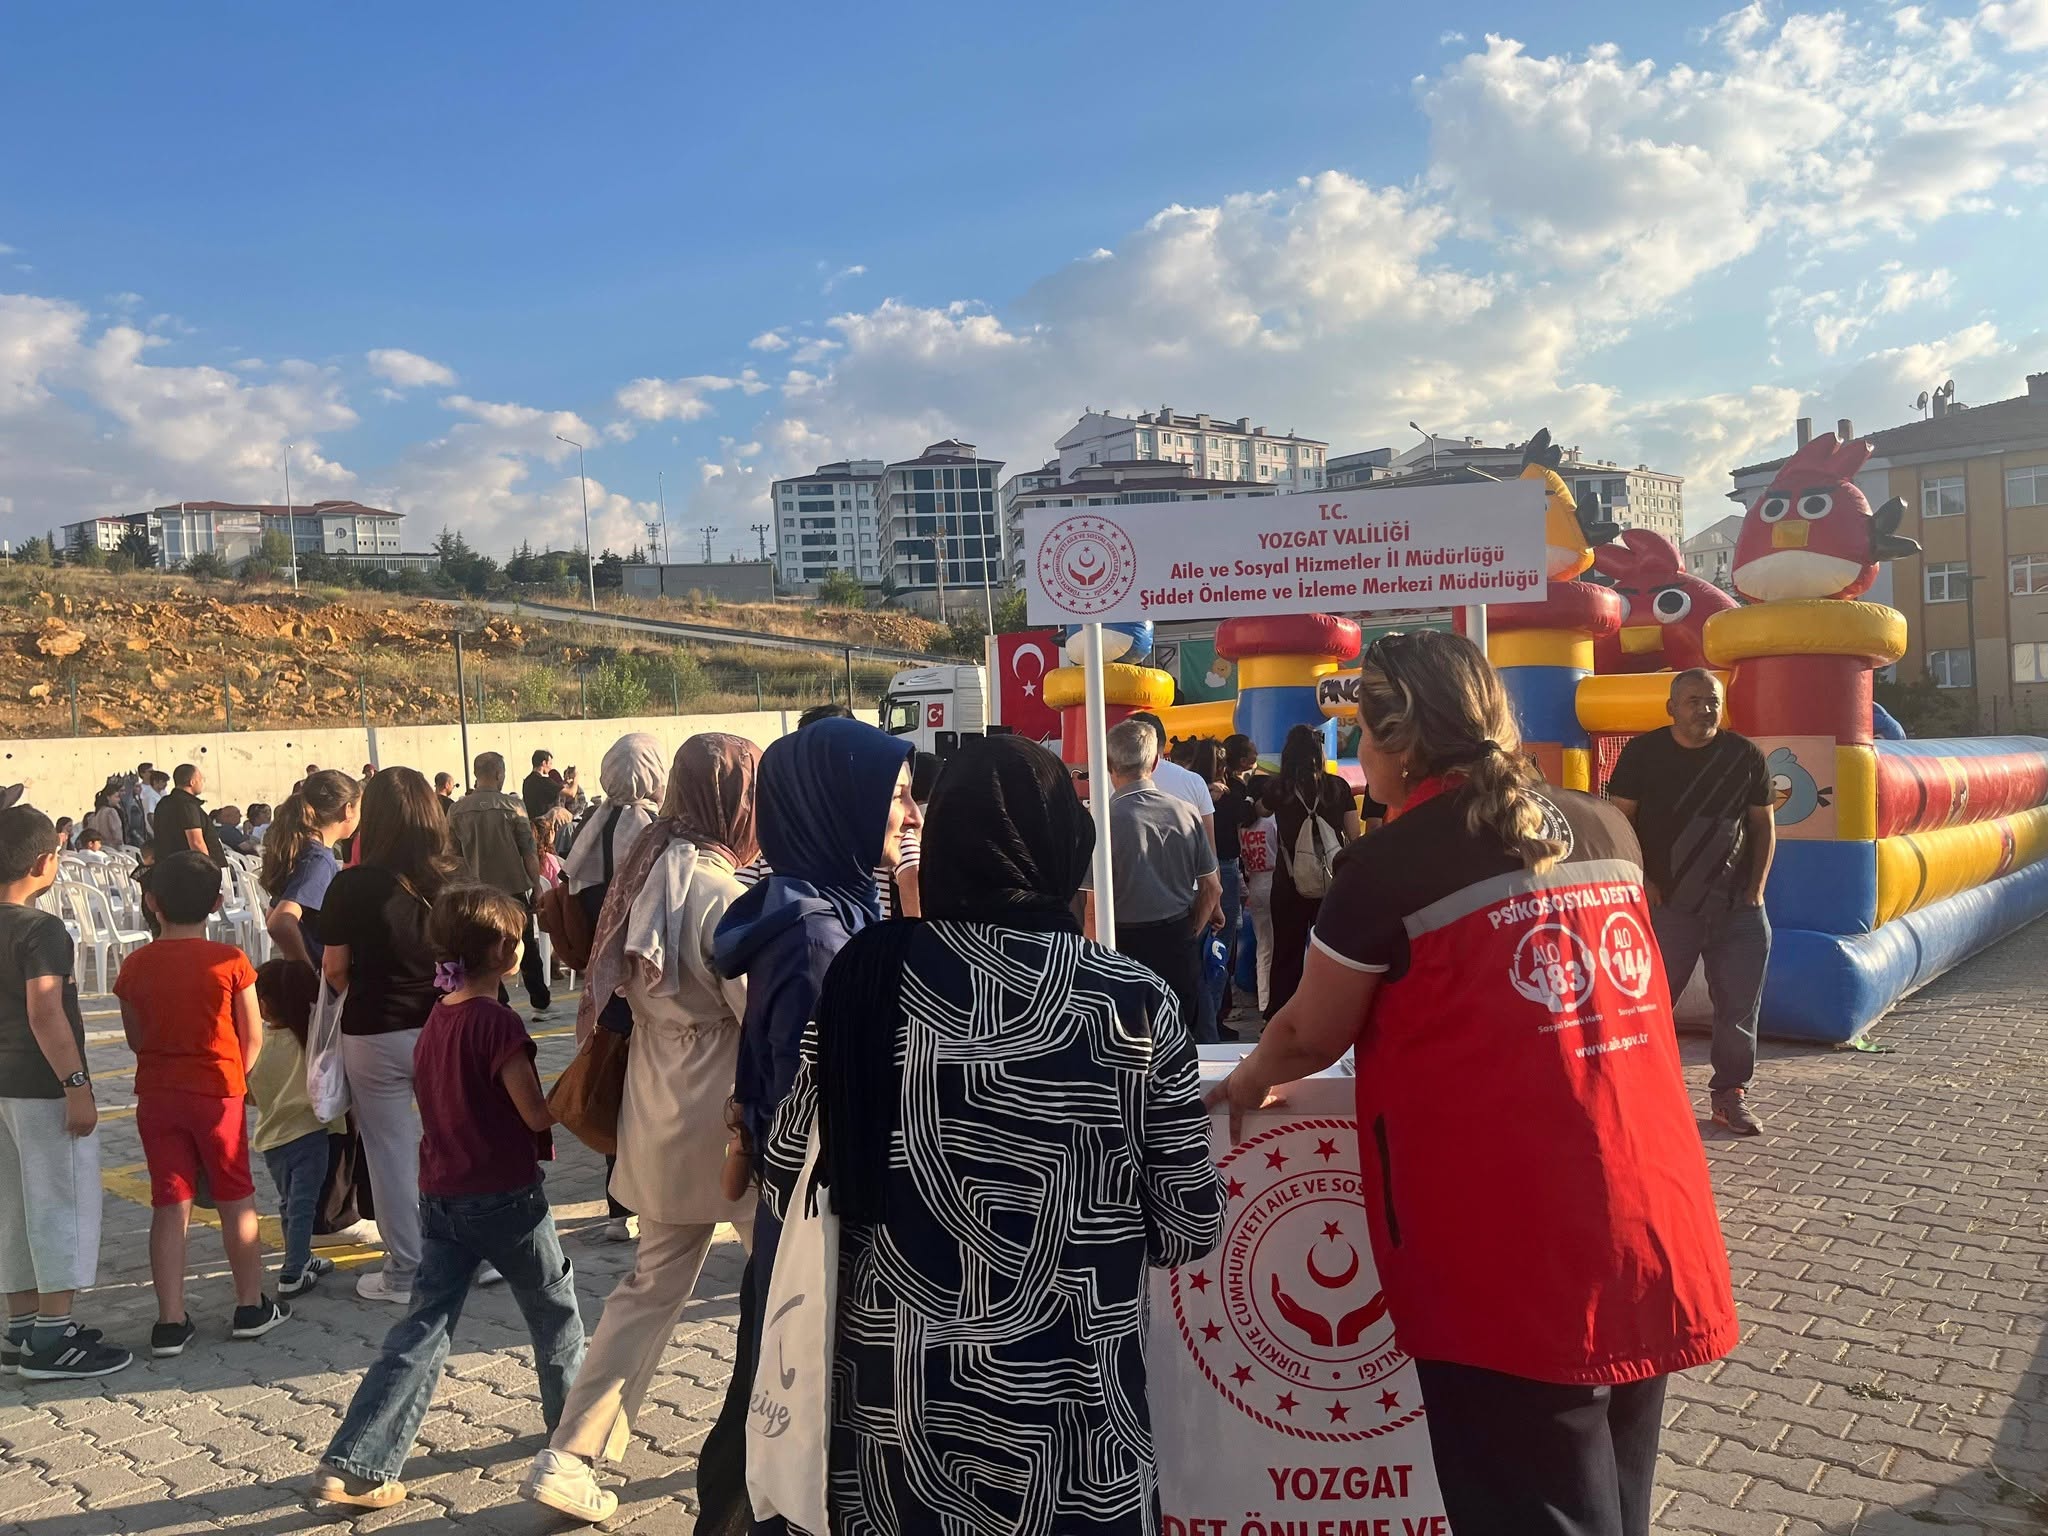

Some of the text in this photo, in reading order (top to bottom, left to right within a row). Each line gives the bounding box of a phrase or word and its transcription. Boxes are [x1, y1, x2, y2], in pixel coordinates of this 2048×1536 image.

[1319, 503, 1348, 521] T.C.
[1086, 533, 1106, 544] SOSYAL
[1258, 520, 1411, 549] YOZGAT VALİLİĞİ
[1055, 543, 1067, 580] CUMHURİYETİ
[1170, 545, 1505, 581] Aile ve Sosyal Hizmetler İl Müdürlüğü
[1059, 580, 1080, 596] TÜRKİYE
[1139, 569, 1540, 611] Şiddet Önleme ve İzleme Merkezi Müdürlüğü
[1320, 677, 1361, 705] ANG
[1488, 885, 1641, 929] PSİKOSOSYAL DESTE
[1613, 927, 1632, 949] ALO
[1533, 943, 1561, 967] ALO
[1612, 949, 1648, 982] 144
[1529, 960, 1586, 997] 183
[1538, 1021, 1564, 1033] Sosyal
[1229, 1178, 1405, 1381] TÜRKİYE CUMHURİYETİ AİLE VE SOS NLIĞI
[1267, 1464, 1413, 1500] YOZGAT
[1162, 1515, 1227, 1536] DET
[1402, 1516, 1446, 1536] VE
